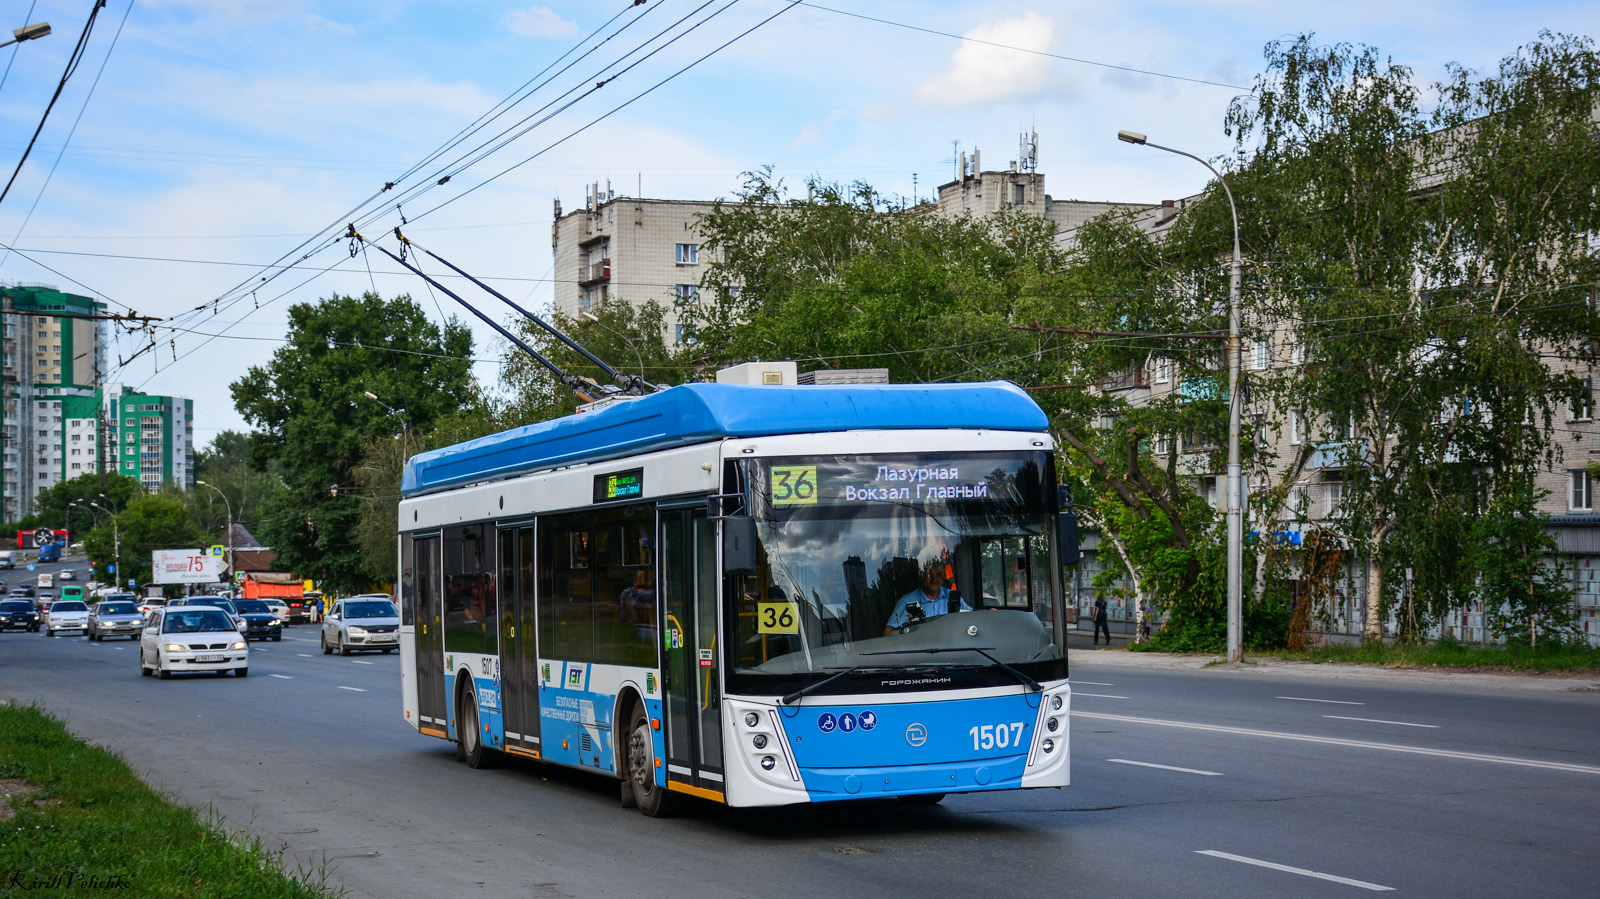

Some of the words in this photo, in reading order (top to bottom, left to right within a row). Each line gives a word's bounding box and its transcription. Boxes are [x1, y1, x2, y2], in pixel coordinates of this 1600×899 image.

[875, 466, 959, 482] Лазурная
[773, 469, 814, 501] 36
[846, 485, 910, 501] Вокзал
[916, 481, 987, 499] Главный
[187, 556, 203, 572] 75
[763, 606, 794, 628] 36
[482, 658, 492, 675] 1507
[881, 677, 951, 686] ГОРОЖАНИН
[969, 721, 1025, 751] 1507
